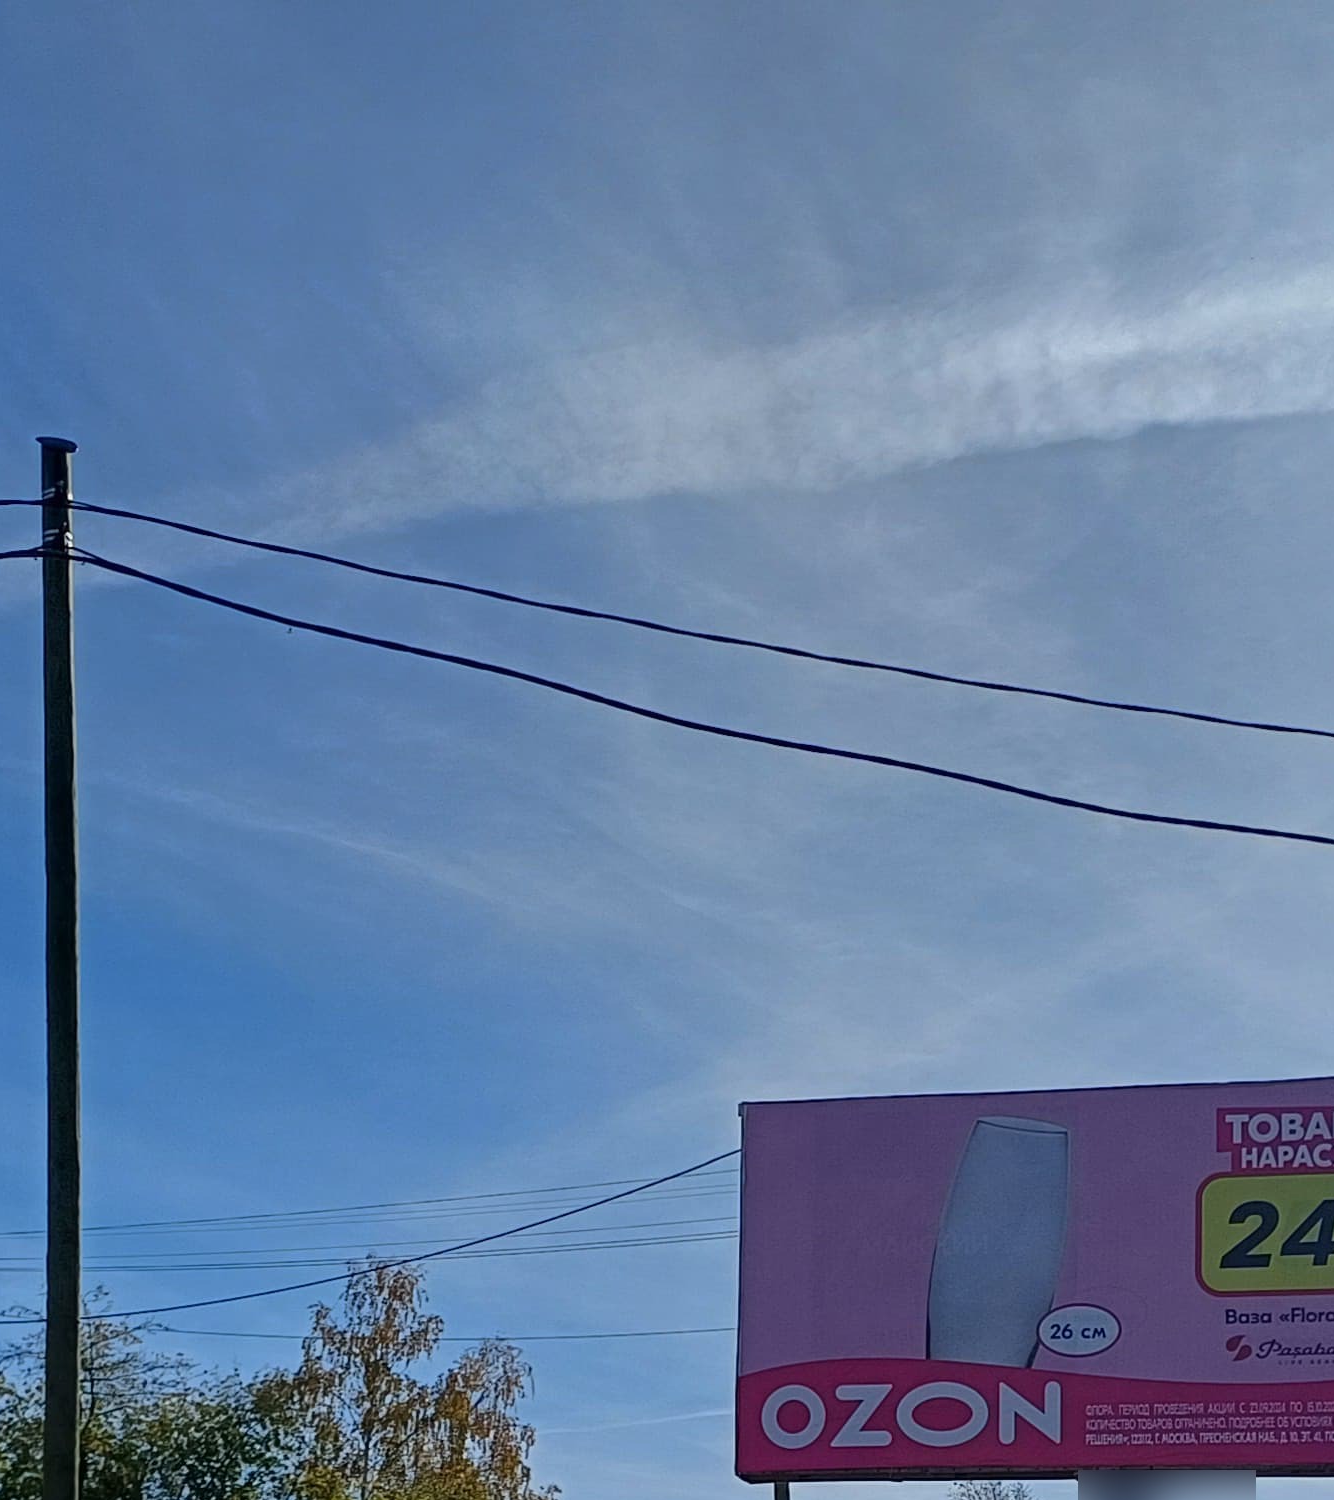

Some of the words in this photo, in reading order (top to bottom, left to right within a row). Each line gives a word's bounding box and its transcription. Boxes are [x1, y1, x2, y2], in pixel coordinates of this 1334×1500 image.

[1224, 1308, 1273, 1325] Ваза
[1049, 1323, 1074, 1341] 26
[1080, 1326, 1108, 1340] см
[760, 1380, 1063, 1450] OZON
[1290, 1401, 1303, 1413] ПО
